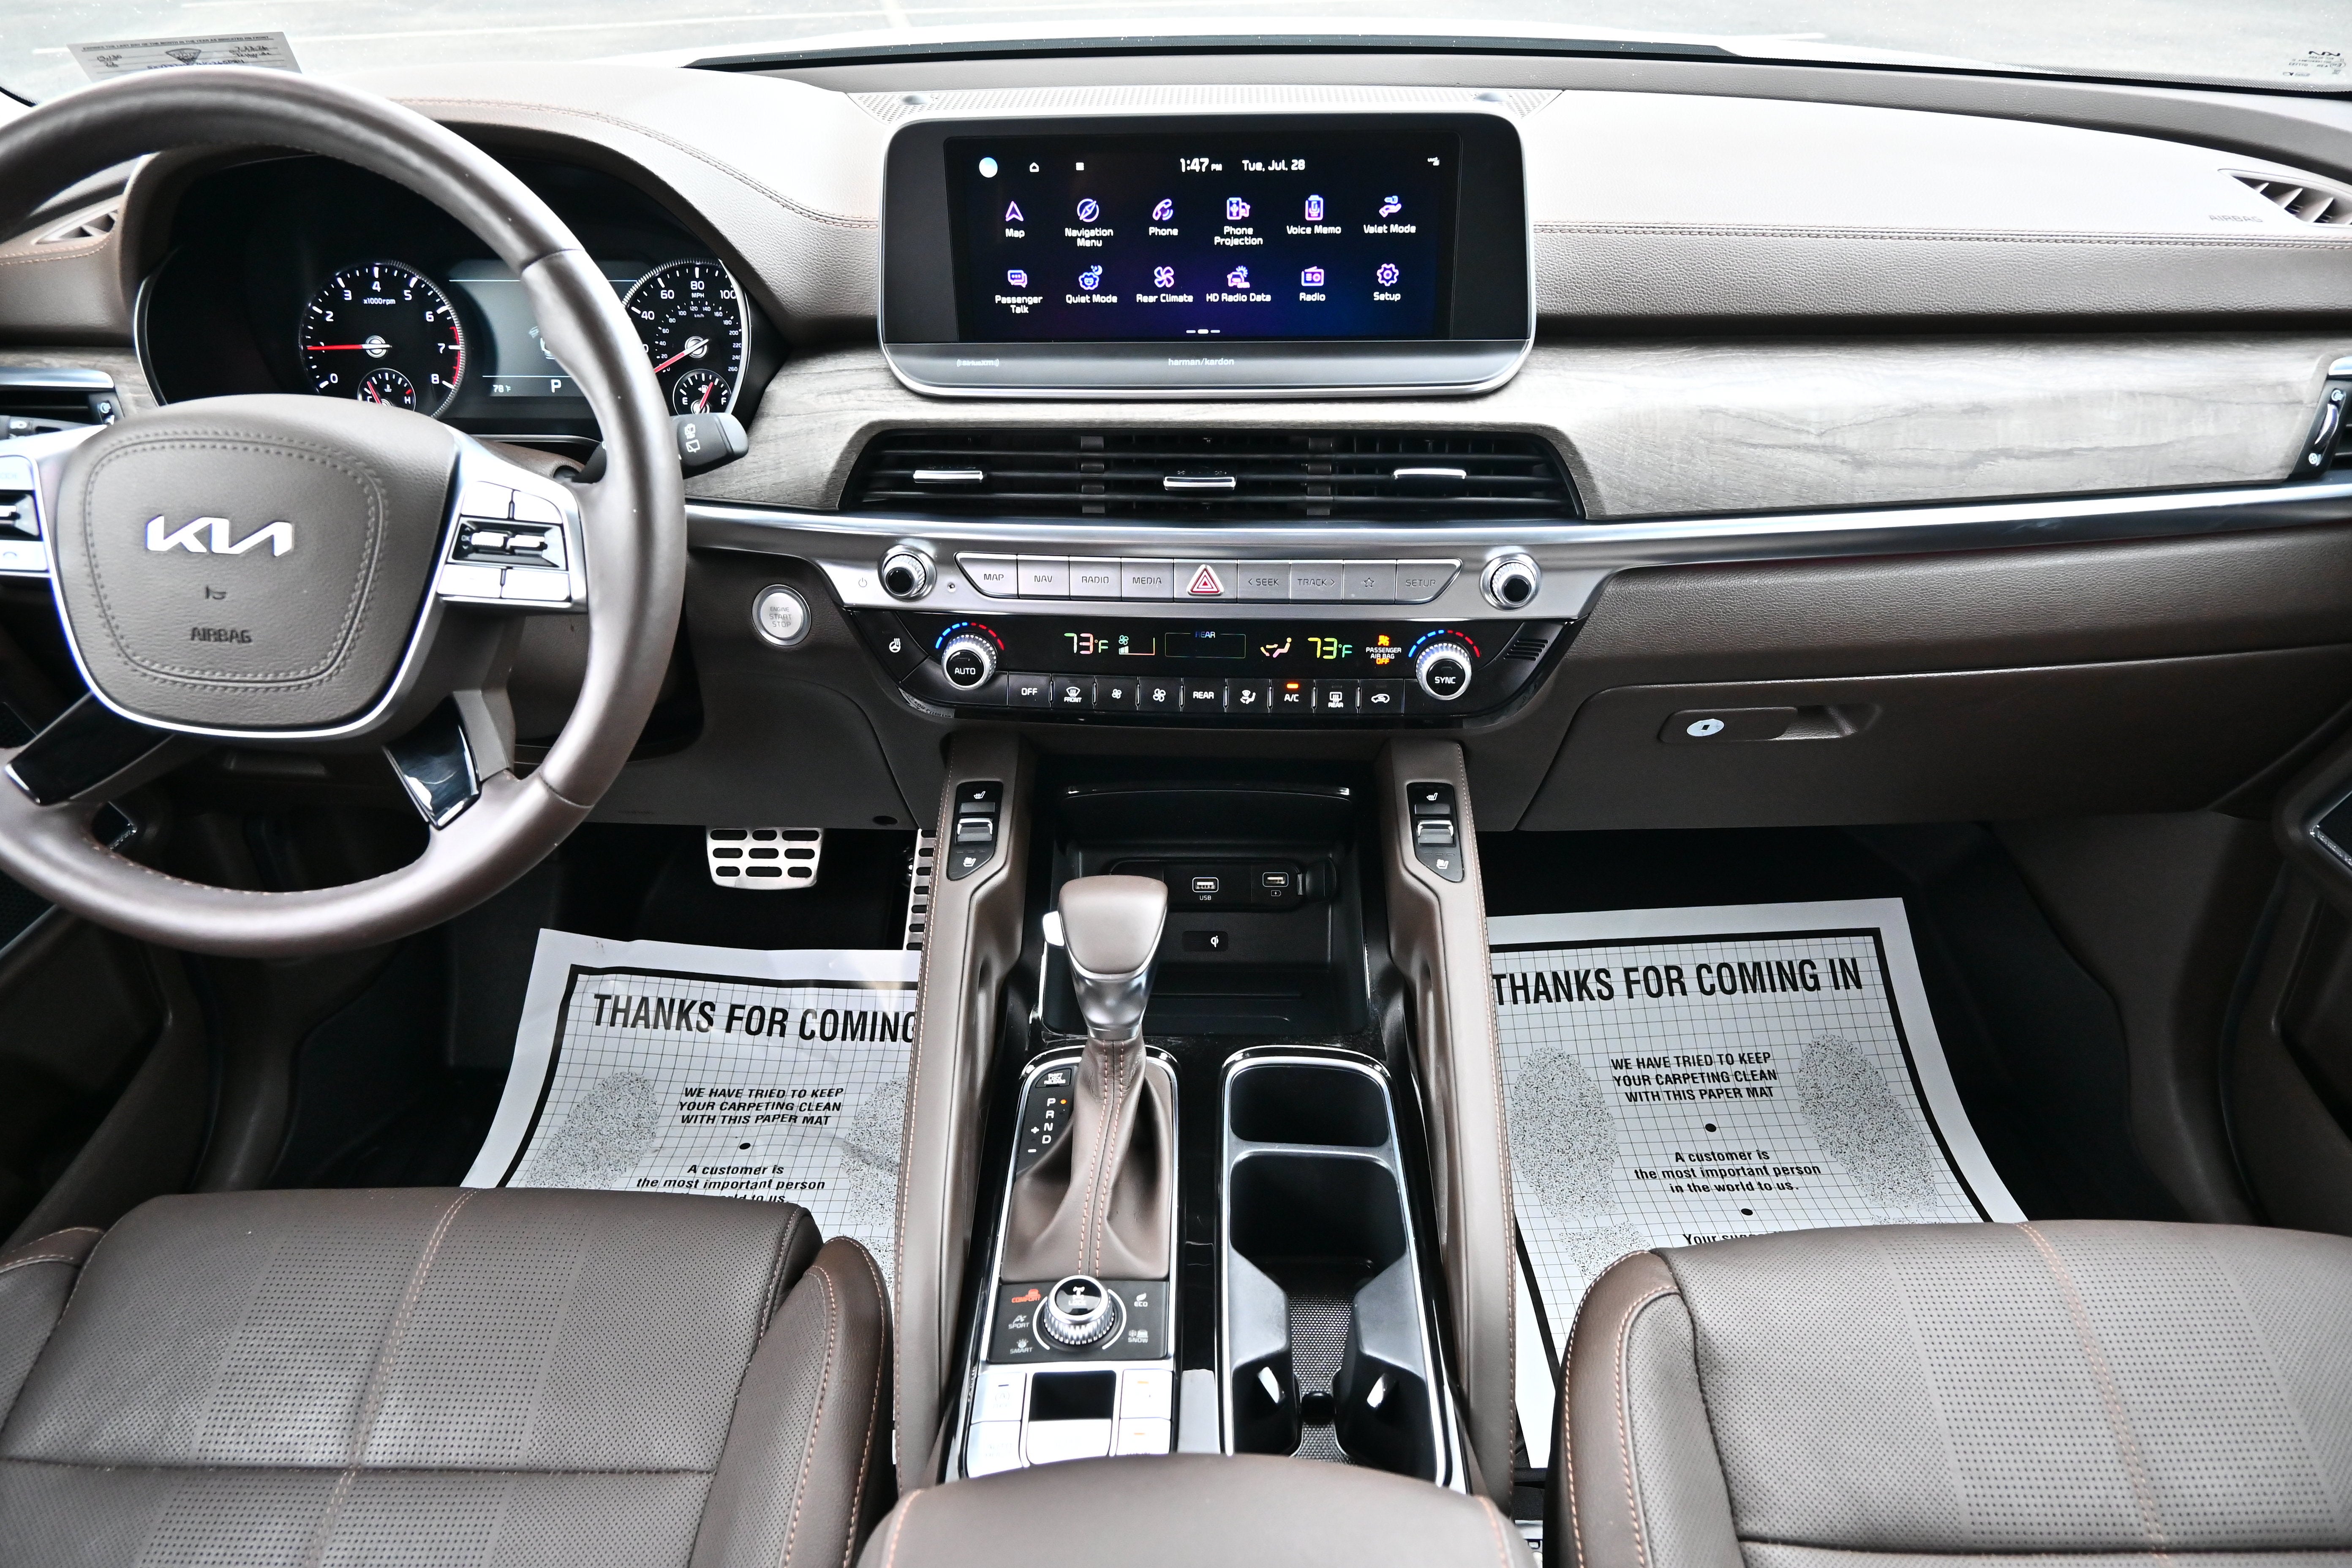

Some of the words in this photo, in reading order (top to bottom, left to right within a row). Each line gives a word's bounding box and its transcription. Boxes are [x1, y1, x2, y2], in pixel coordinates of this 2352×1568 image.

[1180, 158, 1209, 172] 1:47
[1291, 159, 1305, 170] 28
[1005, 229, 1025, 238] Map
[1065, 228, 1113, 237] Navigation
[1149, 226, 1178, 236] Phone
[1224, 226, 1253, 235] Phone
[1286, 225, 1312, 234] Voice
[1314, 225, 1342, 234] Memo
[1363, 224, 1387, 234] Valet
[1390, 224, 1416, 234] Mode
[1077, 238, 1102, 247] Menu
[1214, 236, 1263, 246] Projection
[373, 281, 381, 292] 4
[690, 280, 705, 290] 80
[344, 290, 352, 300] 3
[404, 290, 412, 301] 5
[660, 290, 675, 299] 60
[1066, 294, 1090, 303] Quiet
[1092, 294, 1118, 303] Mode
[1136, 294, 1157, 302] Rear
[1160, 293, 1193, 302] Climate
[1206, 294, 1219, 302] HD
[1221, 293, 1247, 302] Radio
[1250, 293, 1271, 302] Data
[1299, 292, 1326, 302] Radio
[1373, 291, 1401, 302] Setup
[995, 295, 1043, 305] Passenger
[1010, 305, 1029, 313] Talk
[326, 311, 334, 322] 2
[426, 311, 434, 322] 6
[641, 310, 655, 321] 40
[437, 343, 446, 354] 7
[1168, 358, 1234, 366] harman/kardon
[330, 373, 338, 384] 0
[431, 373, 440, 384] 8
[551, 379, 561, 393] P
[682, 397, 688, 405] E
[721, 397, 727, 405] F
[984, 573, 1004, 581] MAP
[1082, 576, 1109, 584] RADIO
[1132, 577, 1162, 585] MEDIA
[1256, 578, 1279, 586] SEEK
[1298, 578, 1327, 586] TRACK
[1405, 579, 1436, 588] SETUP
[191, 626, 252, 644] AIRBAG
[1021, 688, 1037, 696] OFF
[1193, 691, 1214, 700] REAR
[1285, 694, 1299, 702] A/C
[1493, 968, 1614, 1006] THANKS
[1624, 965, 1687, 999] FOR
[1696, 959, 1821, 996] COMING
[1829, 958, 1863, 990] IN
[594, 994, 716, 1032] THANKS
[725, 1004, 787, 1037] FOR
[799, 1008, 915, 1043] COMING
[1611, 1058, 1632, 1070] WE
[1636, 1056, 1670, 1069] HAVE
[1674, 1054, 1713, 1067] TRIED
[1716, 1054, 1734, 1065] TO
[1738, 1052, 1771, 1064] KEEP
[1614, 1075, 1652, 1086] YOUR
[1655, 1071, 1731, 1085] CARPETING
[1734, 1069, 1778, 1082] CLEAN
[685, 1088, 705, 1097] WE
[709, 1088, 743, 1098] HAVE
[748, 1089, 786, 1098] TRIED
[791, 1089, 806, 1098] TO
[811, 1088, 844, 1097] KEEP
[1625, 1091, 1661, 1102] WITH
[1663, 1089, 1696, 1100] THIS
[1699, 1087, 1743, 1100] PAPER
[1747, 1086, 1773, 1097] MAT
[679, 1102, 715, 1111] YOUR
[720, 1102, 794, 1111] CARPETING
[799, 1102, 841, 1111] CLEAN
[1047, 1098, 1056, 1106] P
[681, 1115, 715, 1124] WITH
[721, 1115, 750, 1124] THIS
[754, 1114, 798, 1124] PAPER
[802, 1116, 831, 1125] MAT
[1045, 1111, 1054, 1119] R
[1044, 1123, 1053, 1131] N
[1042, 1135, 1051, 1144] D
[1675, 1152, 1685, 1162] A
[1688, 1150, 1752, 1162] customer
[1758, 1149, 1770, 1160] is
[687, 1165, 697, 1174] A
[702, 1166, 768, 1175] customer
[772, 1165, 784, 1174] is
[1634, 1169, 1657, 1179] the
[1662, 1167, 1697, 1179] most
[1701, 1165, 1769, 1179] important
[1772, 1166, 1821, 1177] person
[637, 1178, 658, 1187] the
[663, 1179, 699, 1188] most
[703, 1179, 772, 1191] important
[776, 1181, 825, 1190] person
[1669, 1184, 1684, 1193] in
[1687, 1183, 1710, 1192] the
[1714, 1181, 1754, 1192] world
[1758, 1181, 1772, 1191] to
[1777, 1182, 1799, 1190] us.
[1682, 1234, 1717, 1244] Your
